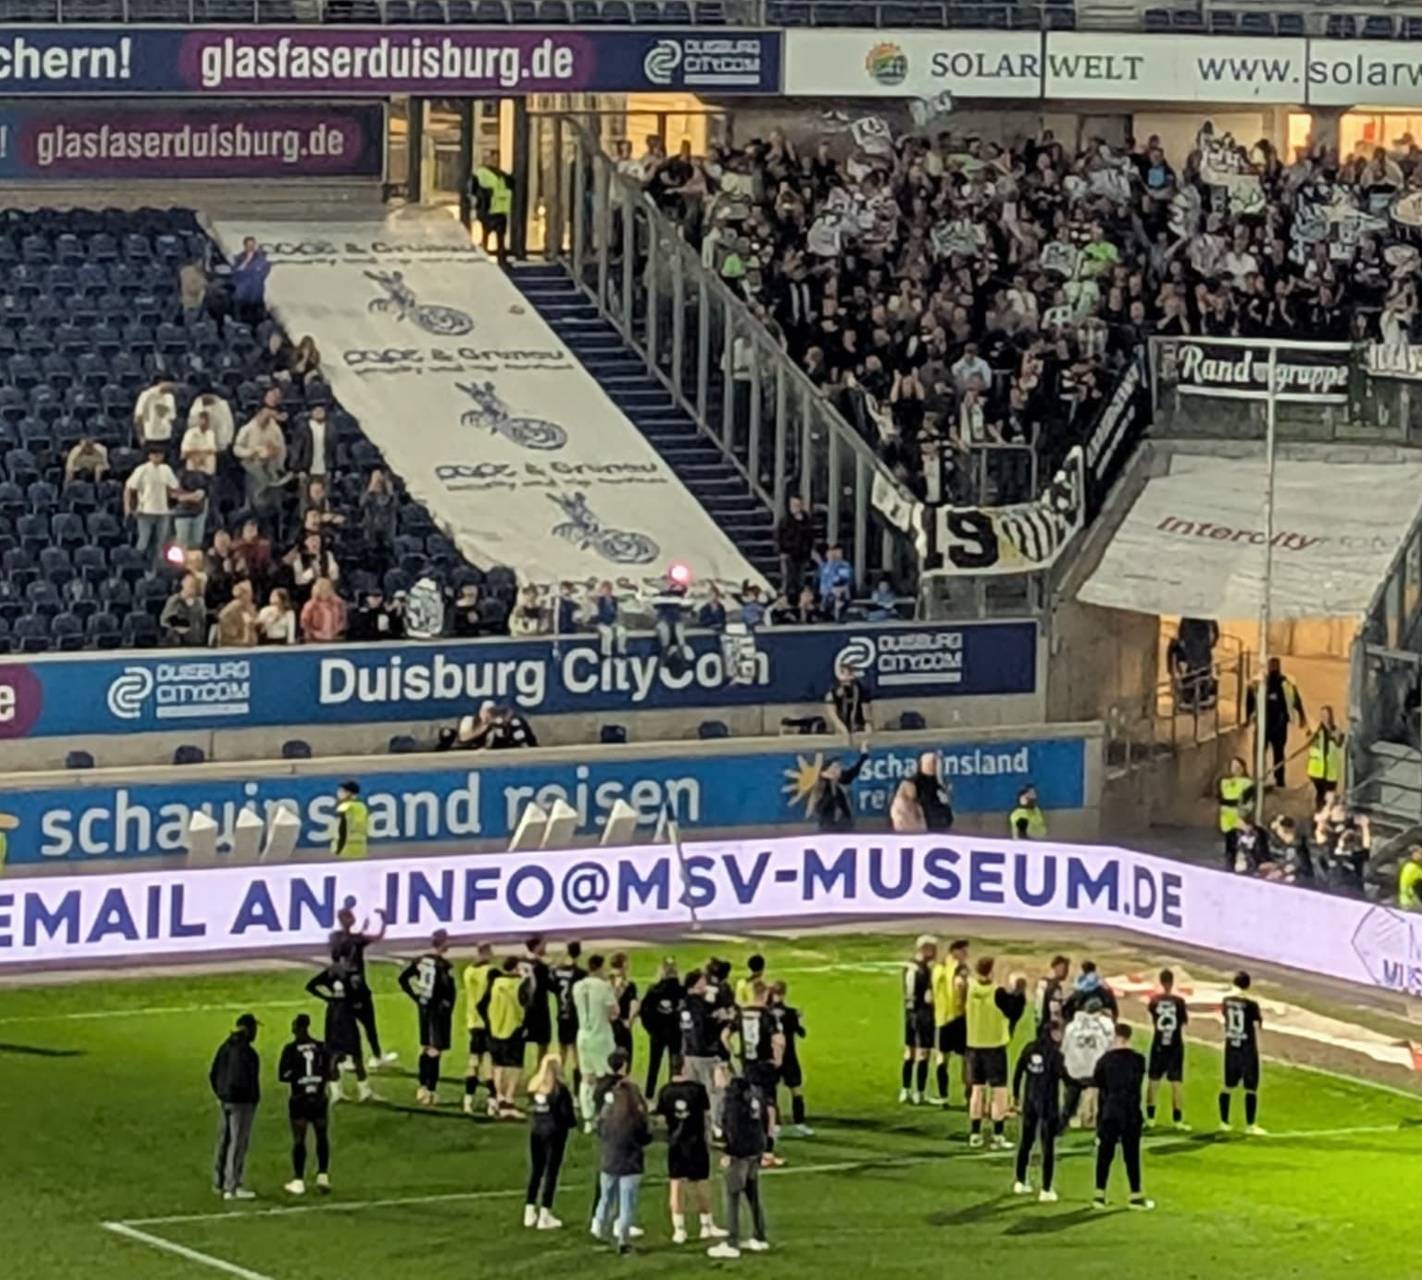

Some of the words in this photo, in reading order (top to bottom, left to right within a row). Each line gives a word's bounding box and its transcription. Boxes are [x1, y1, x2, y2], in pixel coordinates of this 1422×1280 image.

[201, 37, 574, 88] glasfaserduisburg.de
[37, 123, 345, 166] glasfaserduisburg.de
[320, 654, 546, 707] Duisburg
[386, 847, 1183, 927] INFO@MSV-MUSEUM.DE
